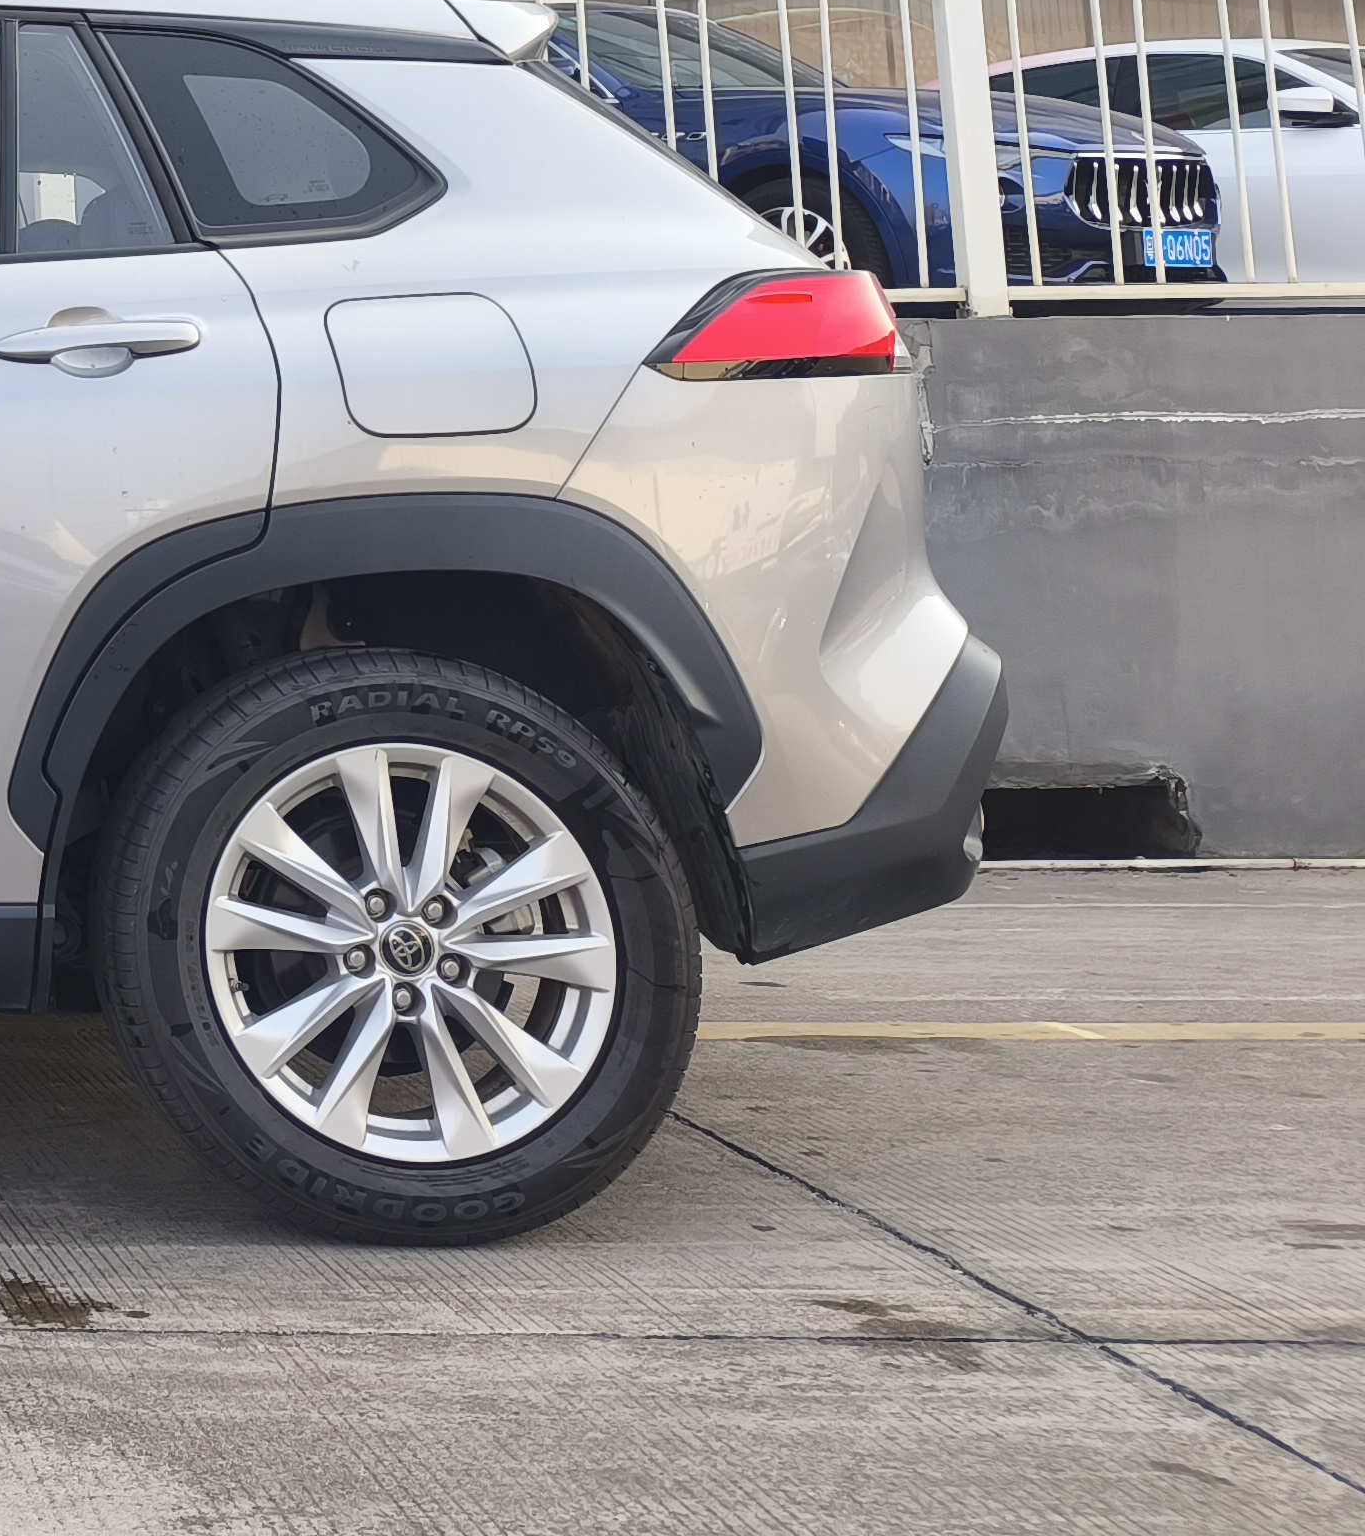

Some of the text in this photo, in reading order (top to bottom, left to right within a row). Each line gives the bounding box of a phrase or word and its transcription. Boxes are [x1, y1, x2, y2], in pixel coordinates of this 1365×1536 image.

[310, 689, 578, 769] RADIAL RP59
[244, 1131, 526, 1222] GOODRIDE
